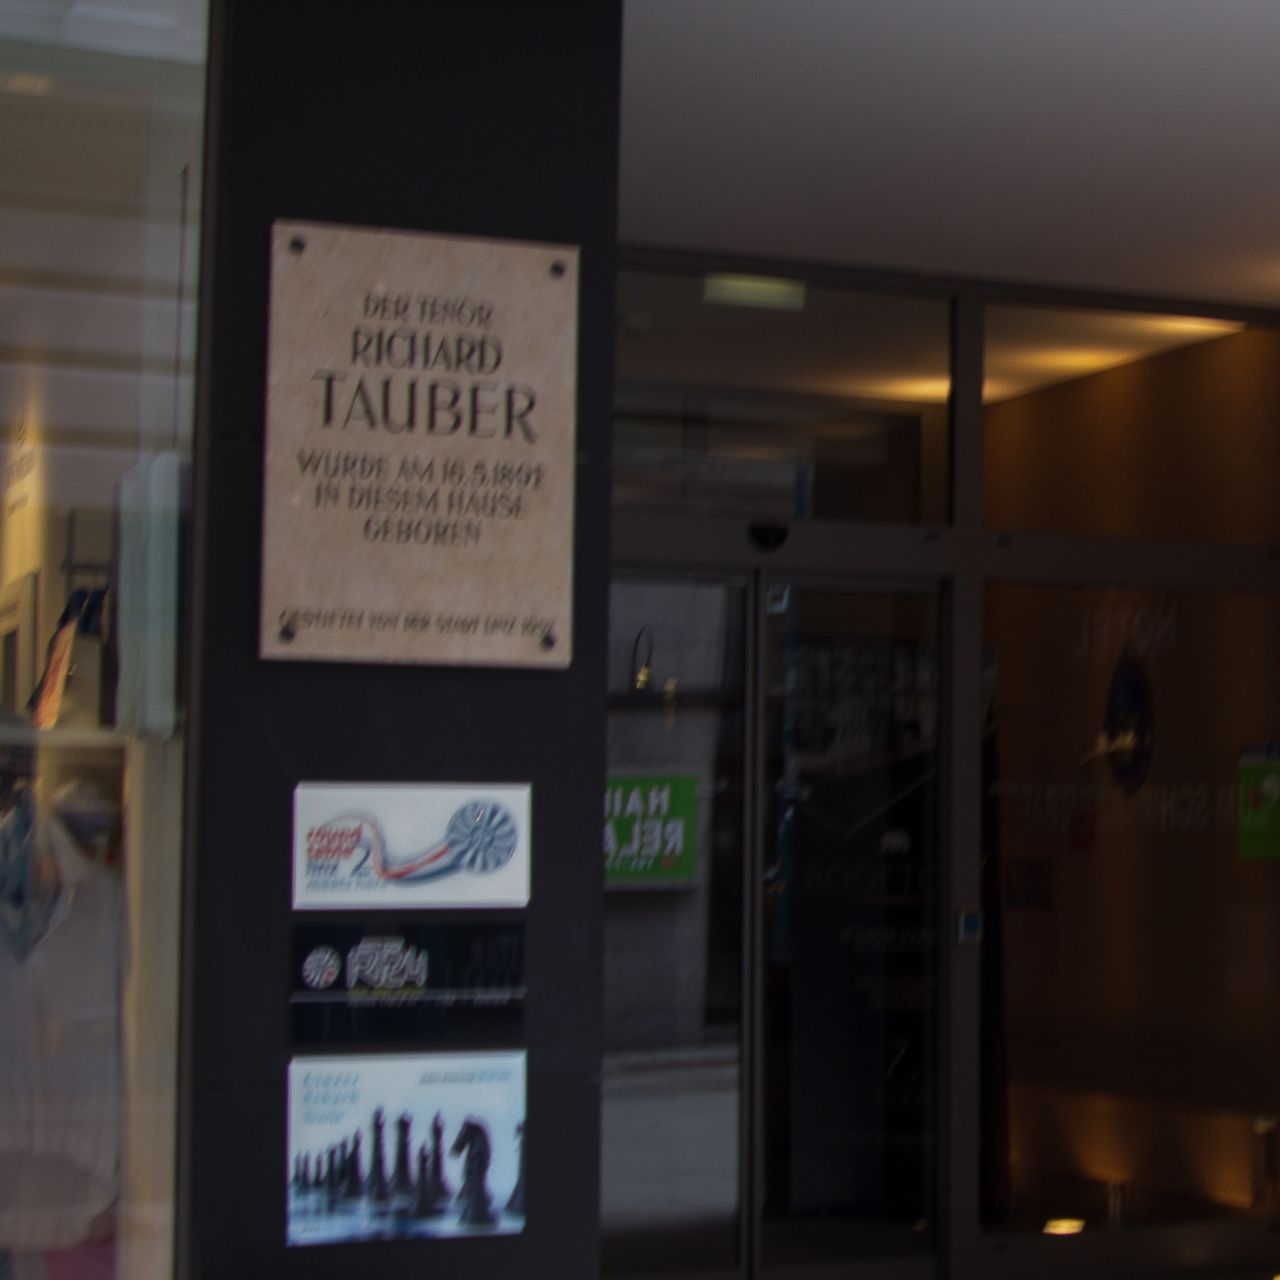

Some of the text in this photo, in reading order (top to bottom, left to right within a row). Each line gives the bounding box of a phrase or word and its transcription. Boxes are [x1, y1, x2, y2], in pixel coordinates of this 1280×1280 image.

[363, 292, 494, 329] DER TENOR
[351, 325, 503, 375] RICHARD
[312, 369, 538, 444] TAUBER
[298, 450, 388, 483] WURDE
[397, 456, 434, 484] AM
[314, 481, 529, 519] IN DIESEM HAUSE
[363, 518, 482, 547] GEBOREN
